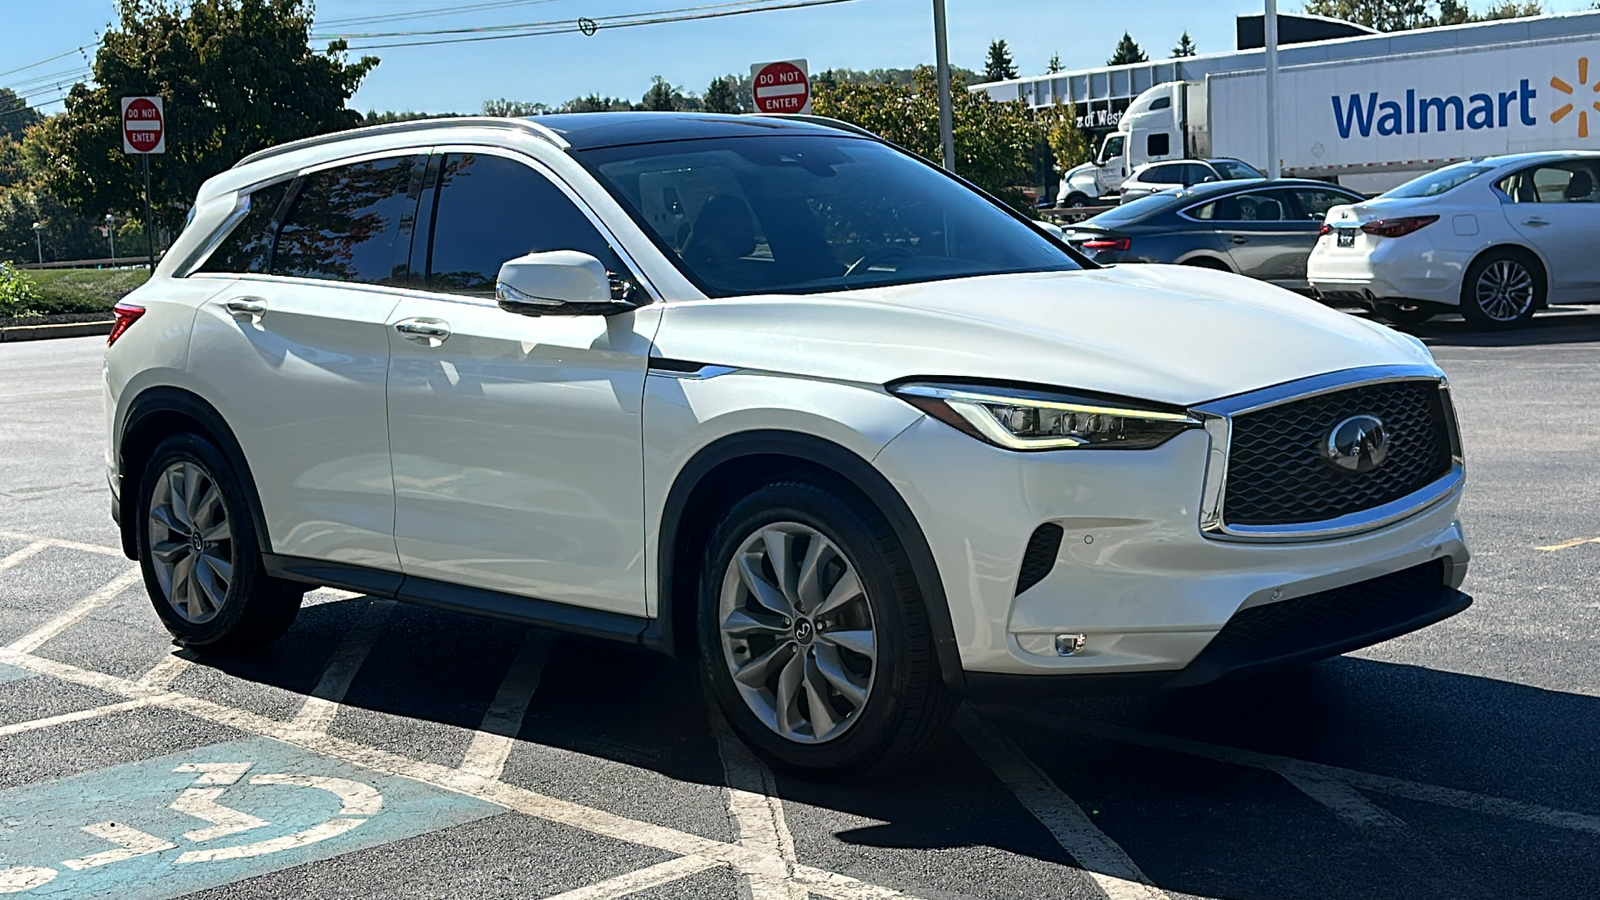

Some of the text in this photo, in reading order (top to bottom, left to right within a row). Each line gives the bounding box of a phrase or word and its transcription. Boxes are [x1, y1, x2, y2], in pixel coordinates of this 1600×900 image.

[760, 72, 799, 84] DO NOT
[766, 98, 798, 109] ENTER
[1331, 79, 1537, 138] Walmart
[128, 109, 155, 118] DO NOT
[1085, 111, 1095, 127] of
[132, 133, 155, 142] ENTER
